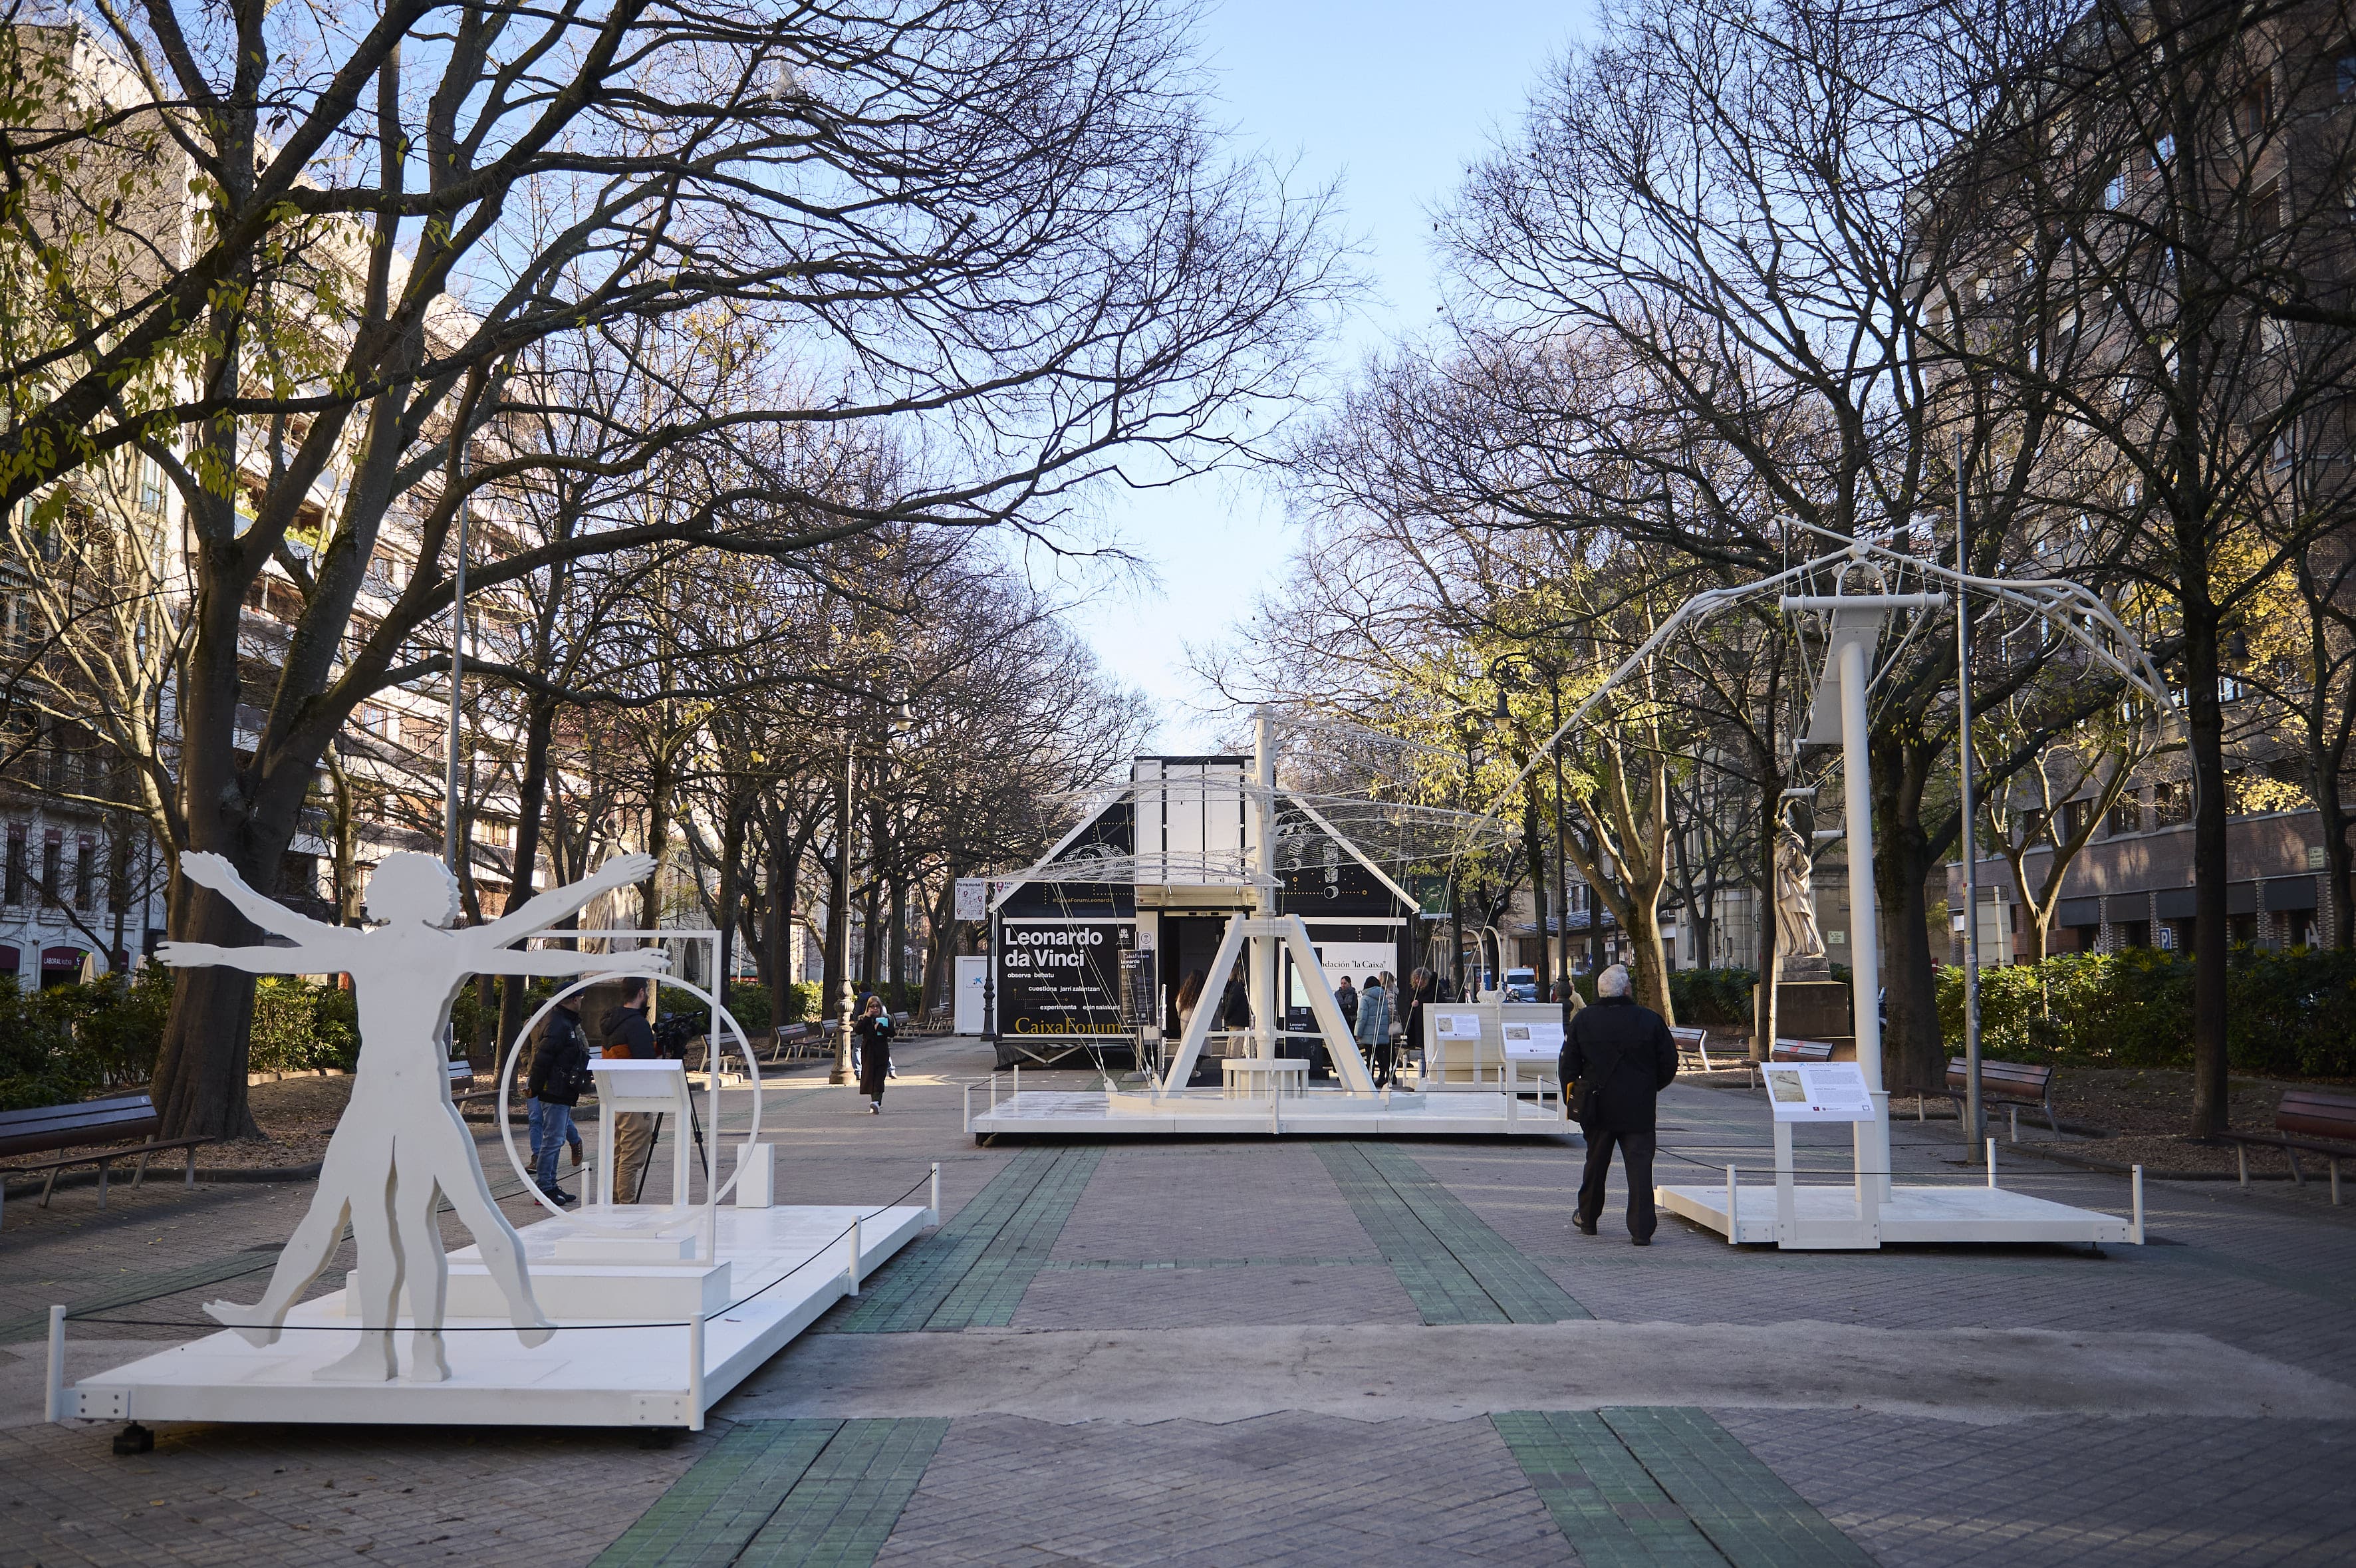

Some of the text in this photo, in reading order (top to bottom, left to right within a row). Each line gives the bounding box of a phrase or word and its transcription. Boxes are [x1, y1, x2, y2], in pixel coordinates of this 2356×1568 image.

[1005, 928, 1103, 946] Leonardo
[1005, 949, 1085, 967] da Vinci
[1015, 1017, 1122, 1034] CaixaForum
